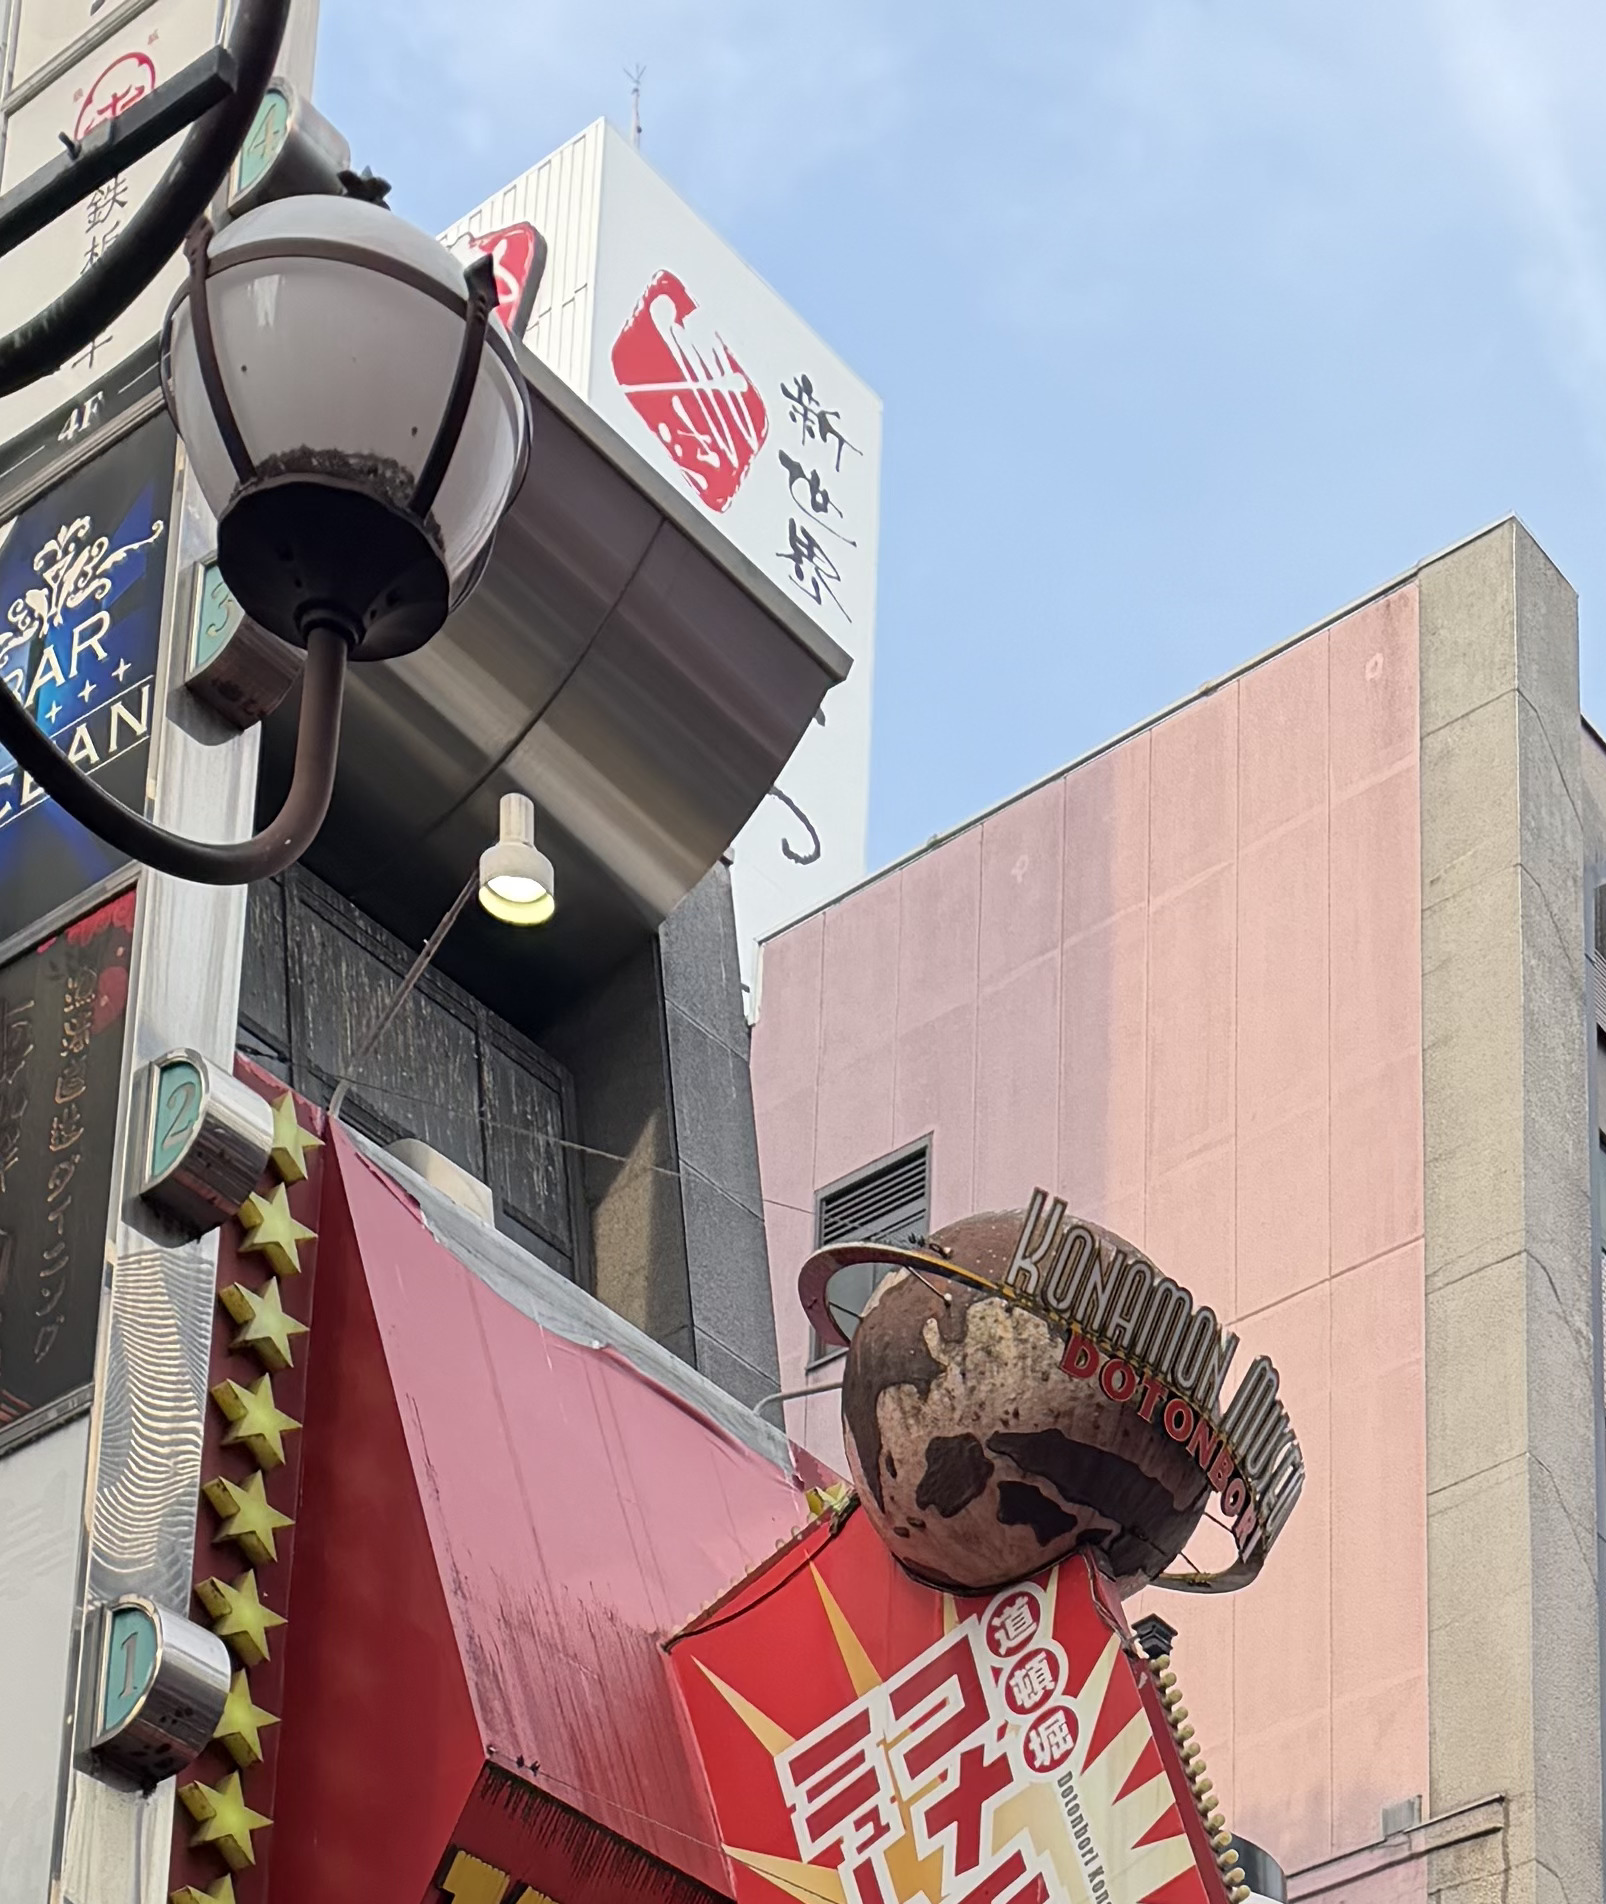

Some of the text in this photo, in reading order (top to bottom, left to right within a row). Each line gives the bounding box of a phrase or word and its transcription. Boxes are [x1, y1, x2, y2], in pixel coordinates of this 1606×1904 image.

[57, 391, 106, 442] 4F
[162, 1081, 197, 1152] 2
[1006, 1187, 1240, 1420] KONAMON
[1061, 1332, 1262, 1563] DOTONBORI
[119, 1631, 139, 1698] 1
[989, 1596, 1075, 1770] 道頓堀
[1057, 1770, 1101, 1866] Dotonbori
